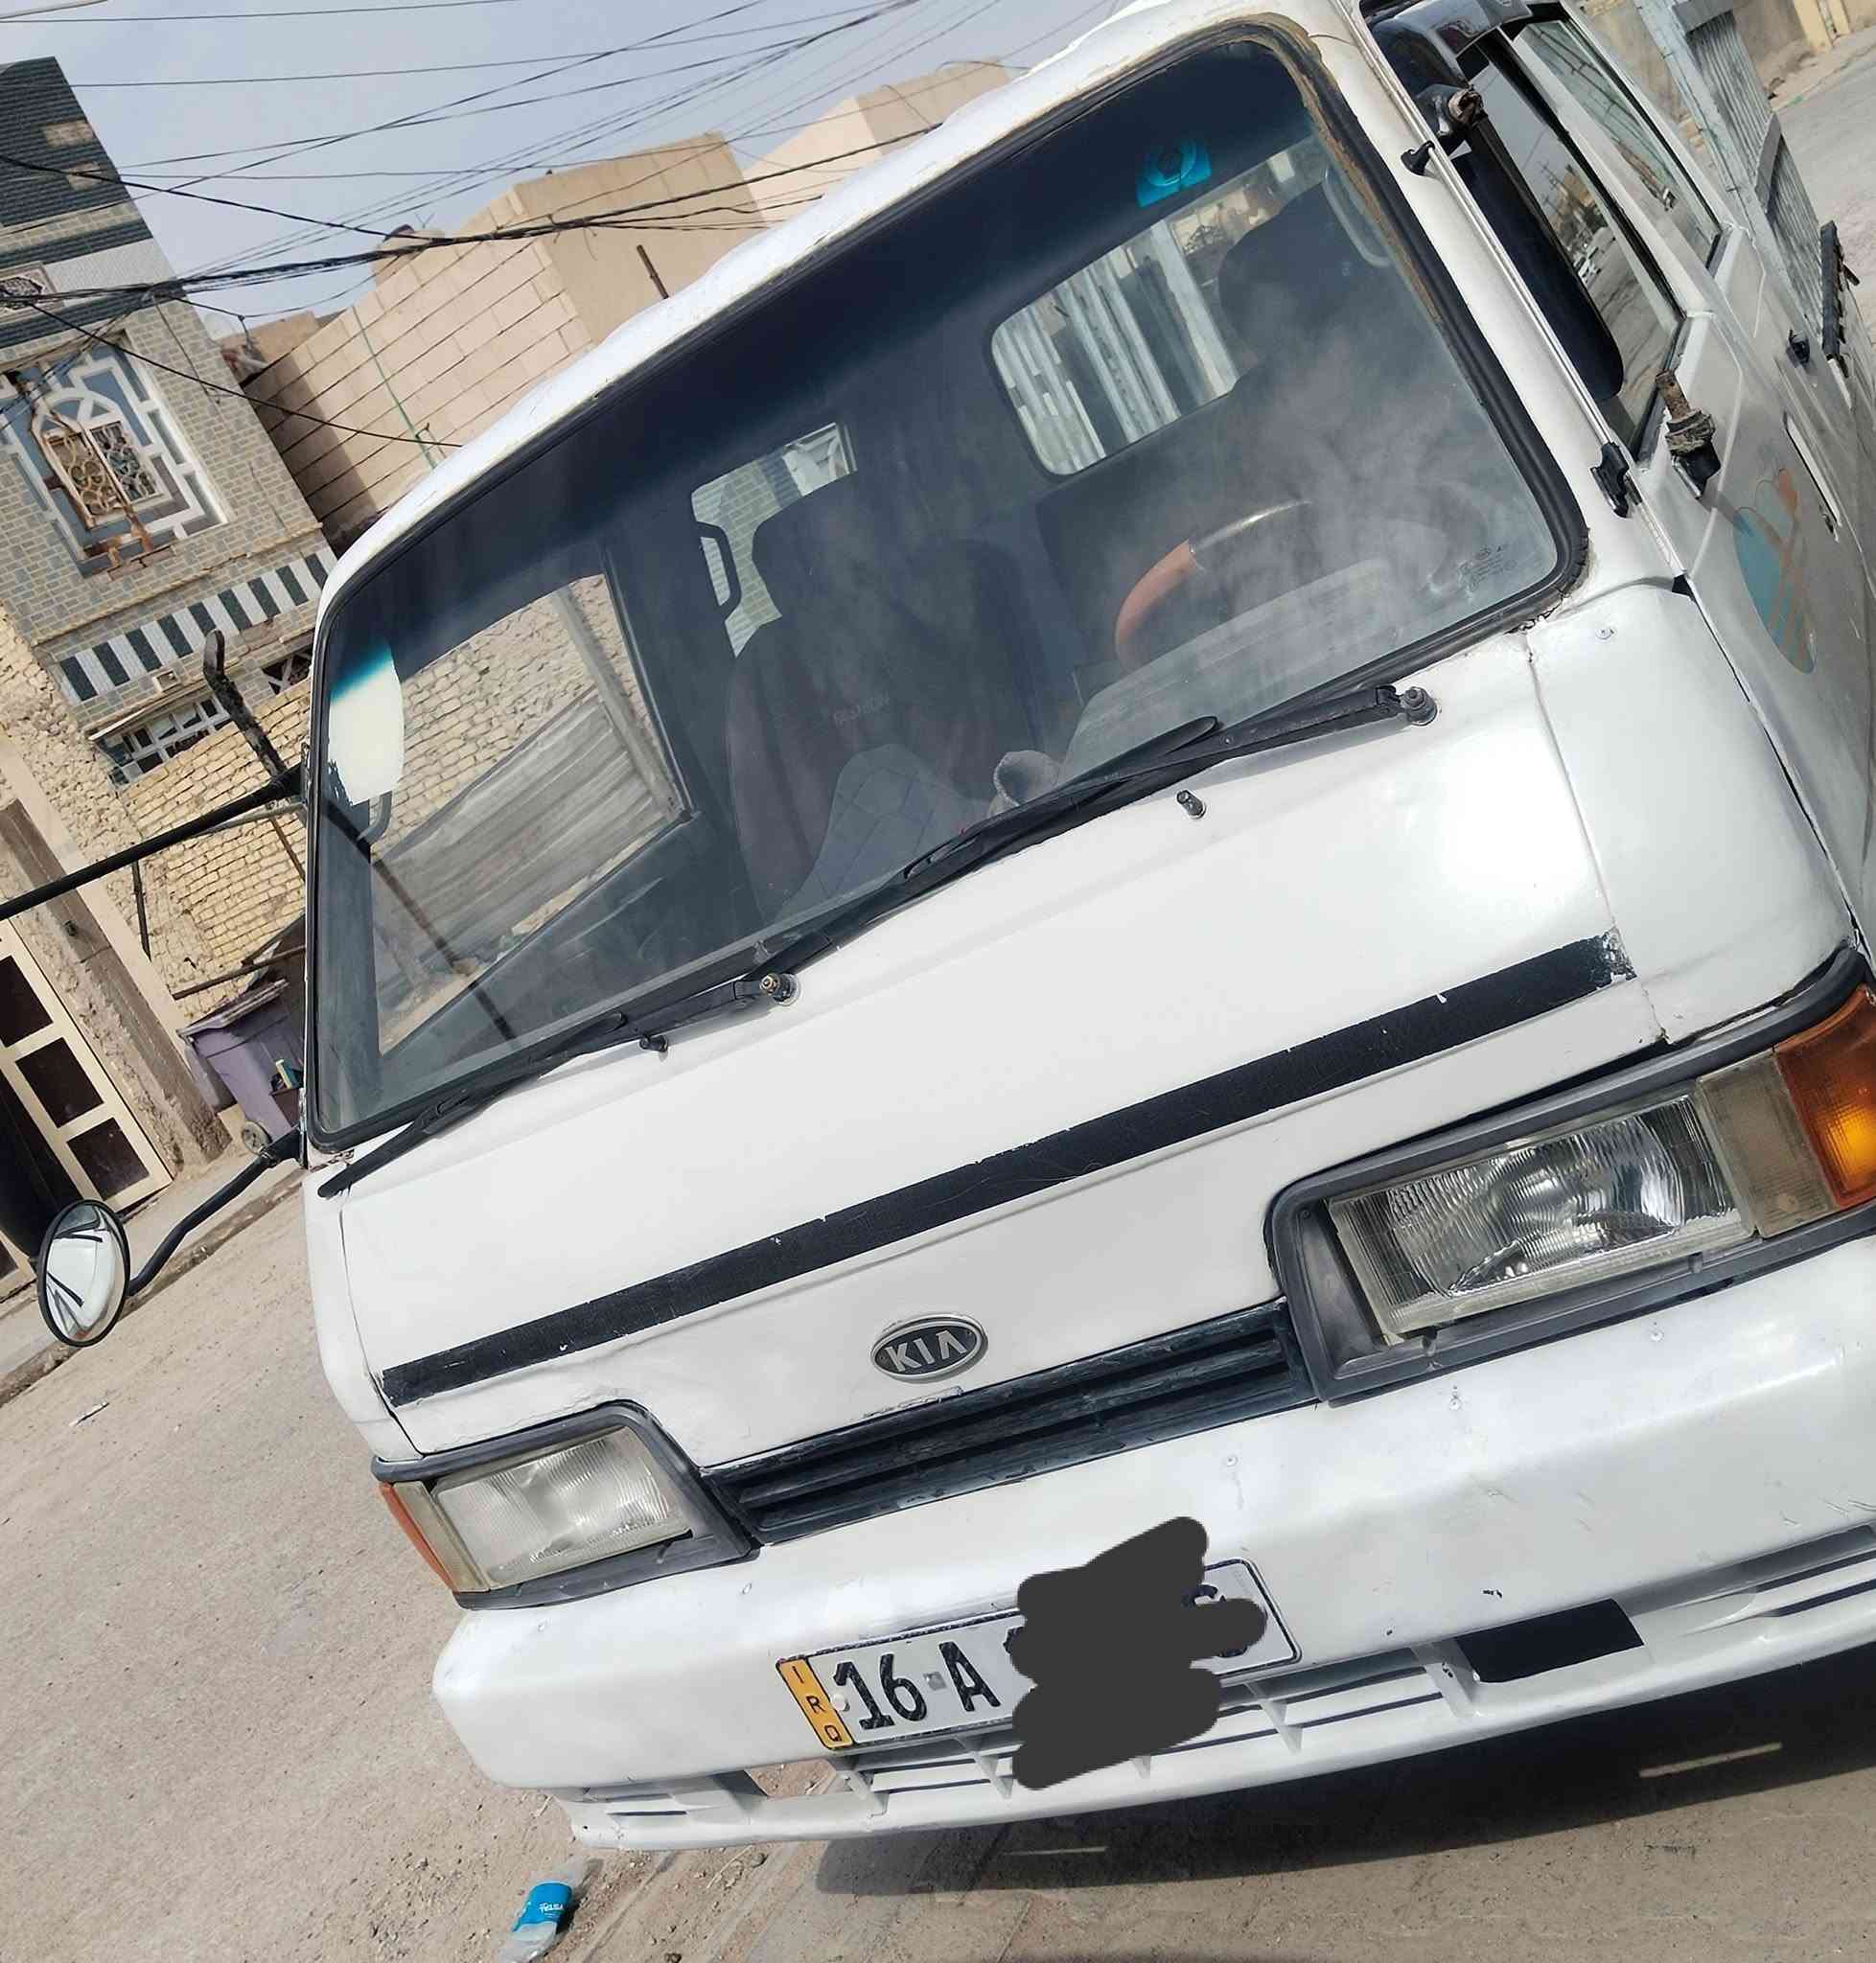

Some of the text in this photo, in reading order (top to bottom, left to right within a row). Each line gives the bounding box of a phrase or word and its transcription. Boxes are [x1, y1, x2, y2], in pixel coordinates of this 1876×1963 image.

[884, 1329, 967, 1373] KIA
[791, 1666, 843, 1742] IRQ
[833, 1641, 1001, 1730] 16 A
